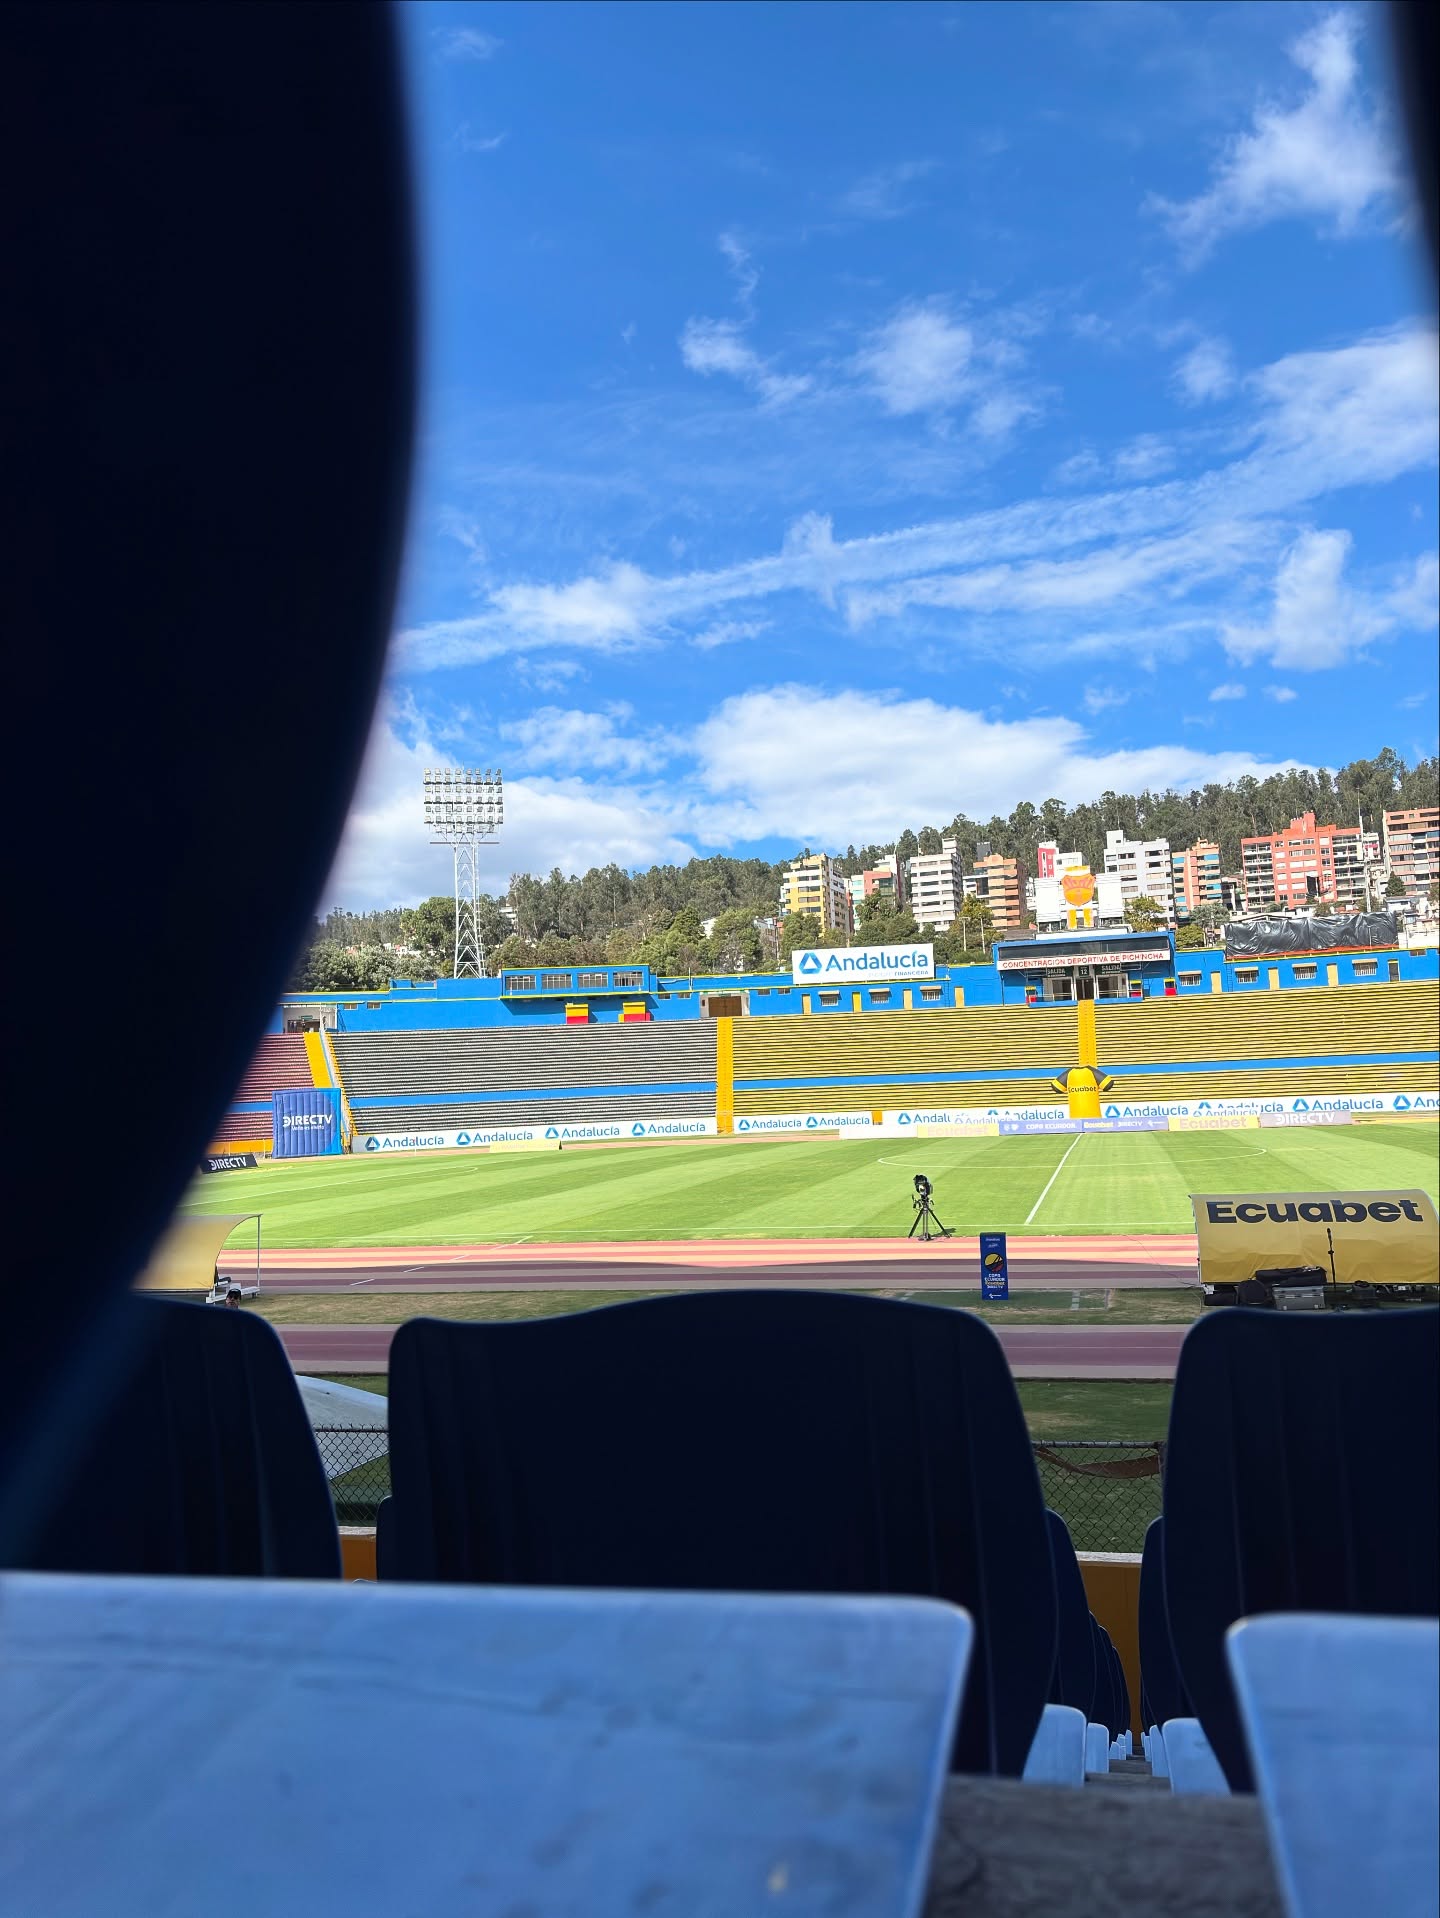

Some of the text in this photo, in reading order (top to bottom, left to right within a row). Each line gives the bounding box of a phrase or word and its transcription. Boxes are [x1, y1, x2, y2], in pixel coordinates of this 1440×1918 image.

[825, 950, 929, 972] Andalucía
[1067, 956, 1108, 965] DEPORTIVA
[1122, 953, 1164, 961] PICHINCHA
[1312, 1098, 1383, 1110] Andalucía
[1005, 1109, 1065, 1121] ndalucía
[1123, 1105, 1189, 1117] Andalucía
[283, 1114, 332, 1127] DIRECTV
[752, 1118, 802, 1129] Andalucía
[819, 1116, 870, 1126] Andalucía
[1180, 1116, 1247, 1129] Ecuabet
[1275, 1112, 1335, 1125] DIRECTV
[562, 1126, 620, 1138] Andalucía
[648, 1122, 706, 1134] Andalucía
[382, 1136, 444, 1148] Andalucía
[473, 1131, 533, 1143] Andalucía
[208, 1157, 246, 1170] DIRECTV
[1206, 1199, 1424, 1224] Ecuabet
